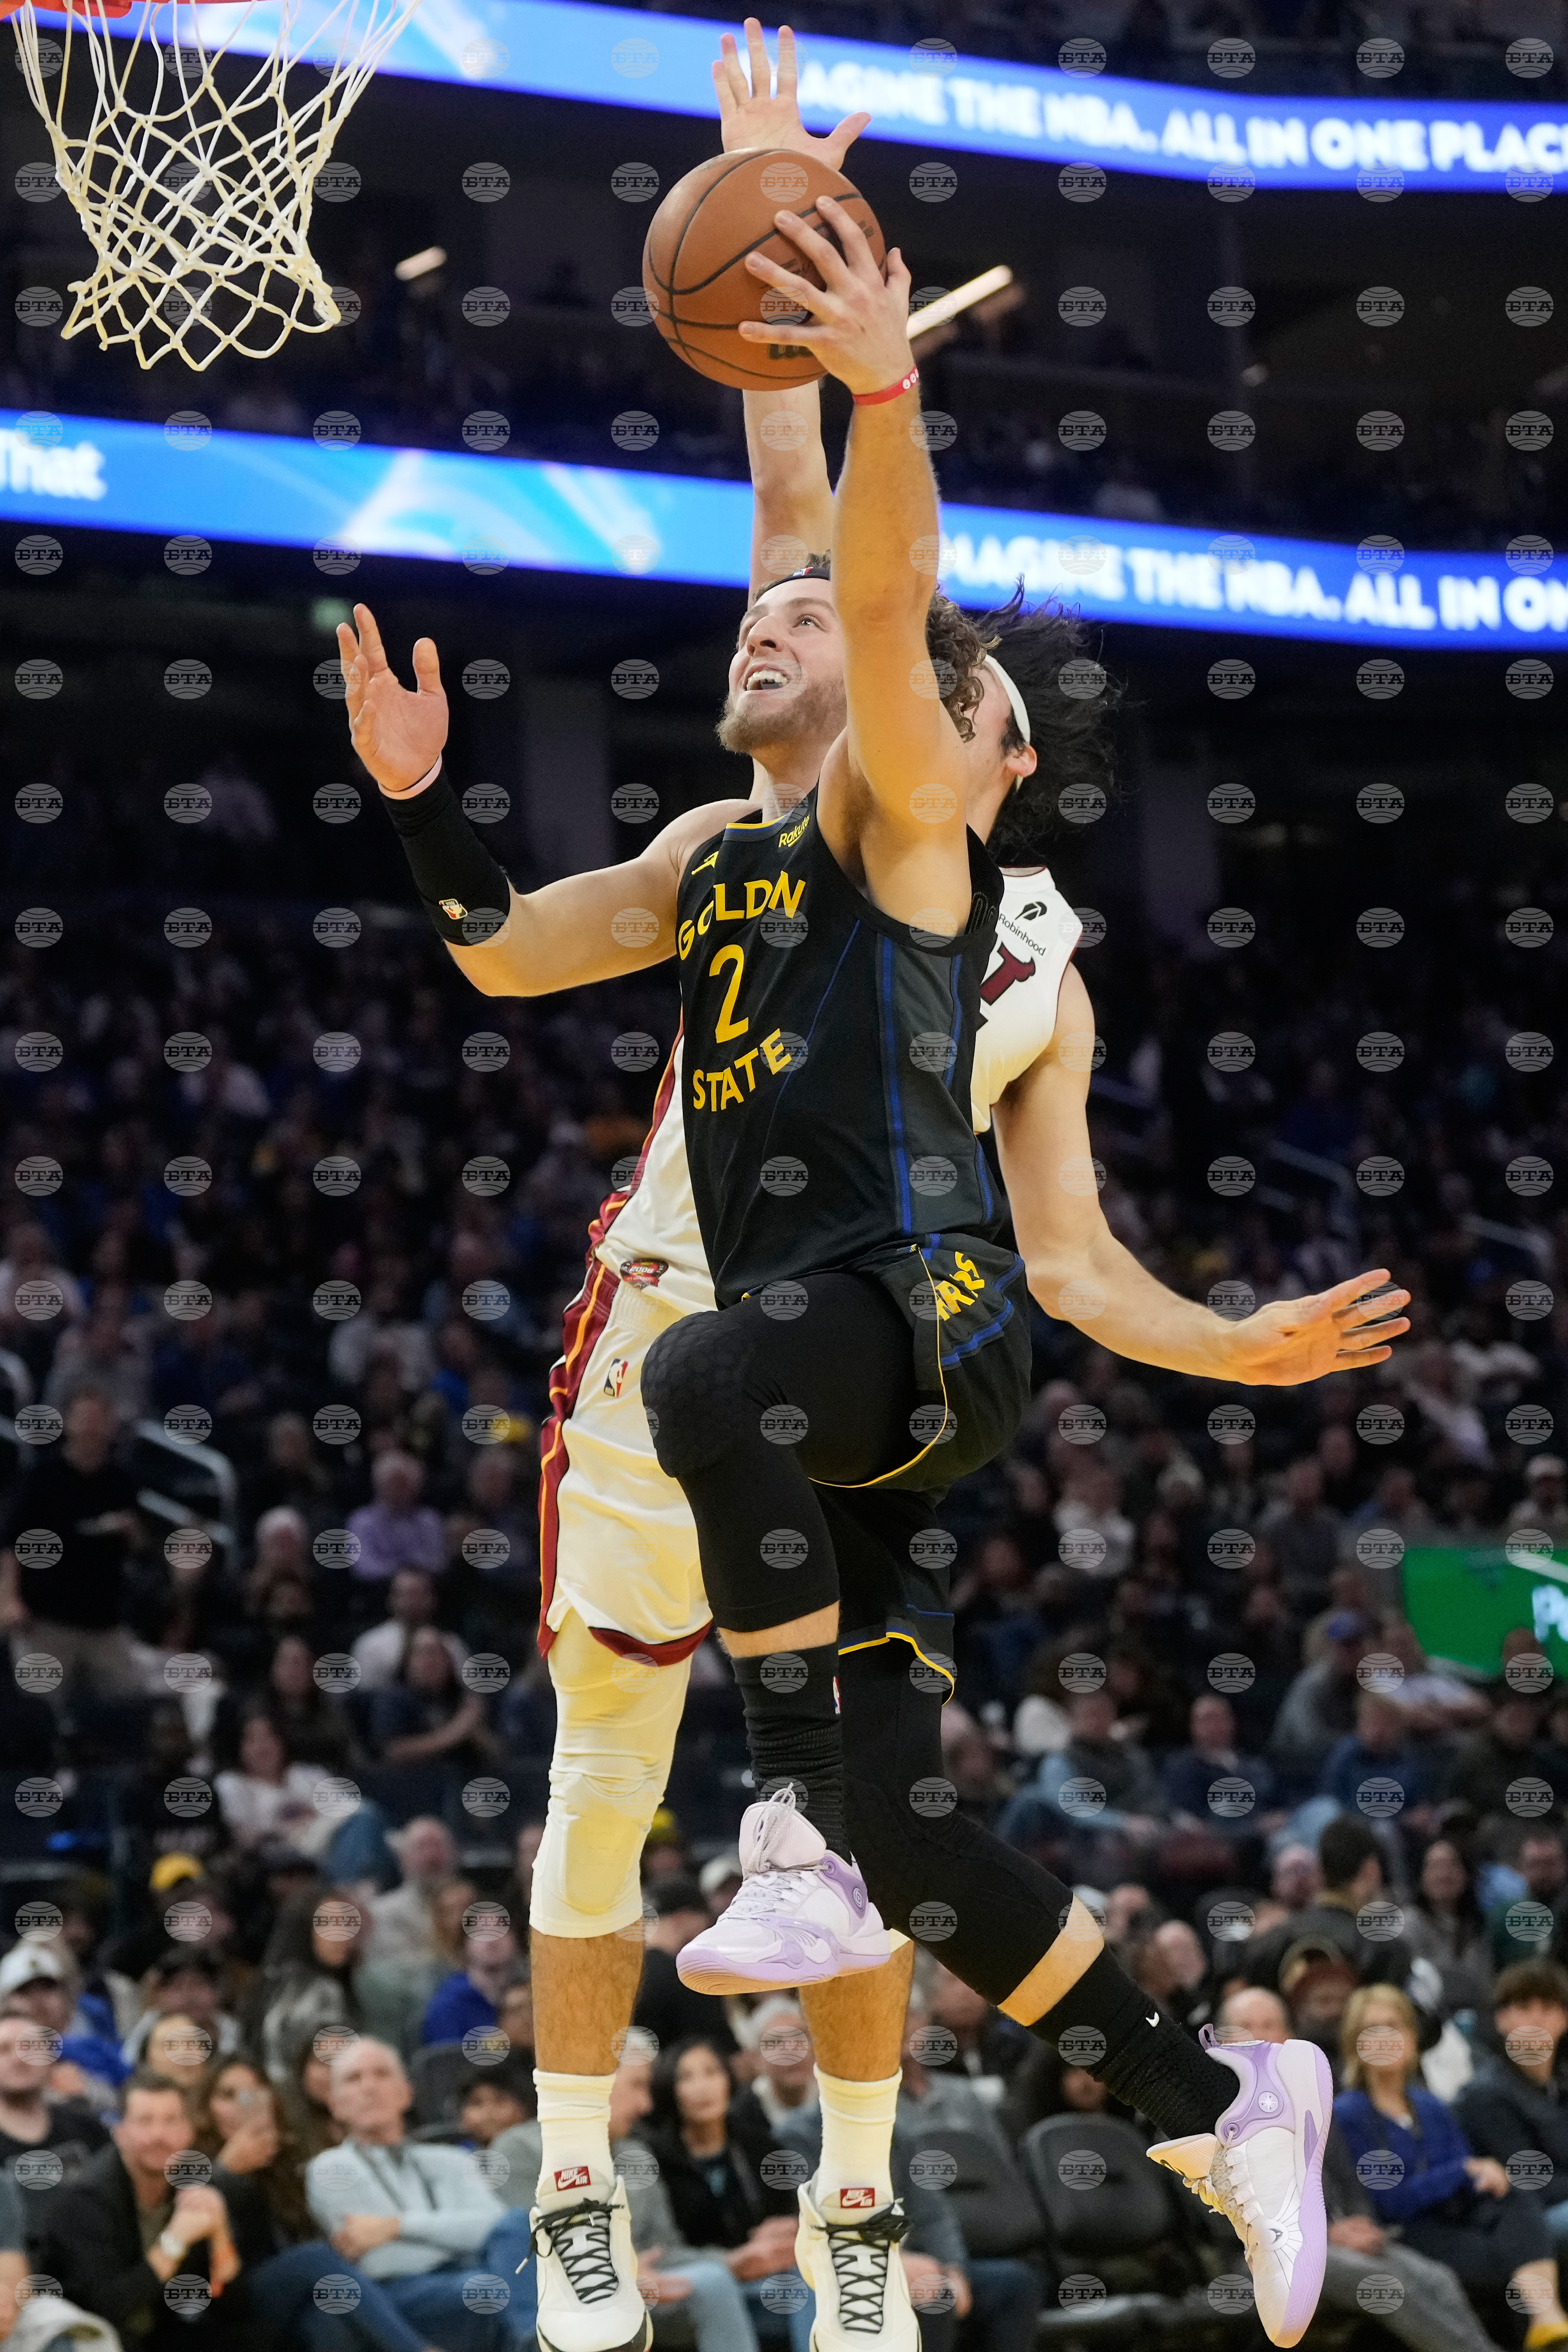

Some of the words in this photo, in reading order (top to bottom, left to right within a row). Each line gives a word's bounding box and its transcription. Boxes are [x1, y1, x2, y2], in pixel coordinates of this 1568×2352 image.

[738, 48, 948, 126] AGINE
[948, 77, 1041, 140] THE
[1161, 107, 1246, 164] ALL
[1245, 117, 1310, 168] IN
[1310, 117, 1428, 171] ONE
[1429, 119, 1568, 174] PLAC
[1125, 547, 1224, 610] THE
[1343, 570, 1436, 630] ALL
[1438, 575, 1501, 632] IN
[778, 814, 810, 848] Rakute
[999, 913, 1046, 956] Robinhood
[709, 944, 749, 1044] 2
[693, 1028, 792, 1112] STATE
[560, 2167, 578, 2181] NIKE
[846, 2189, 866, 2199] NIKE
